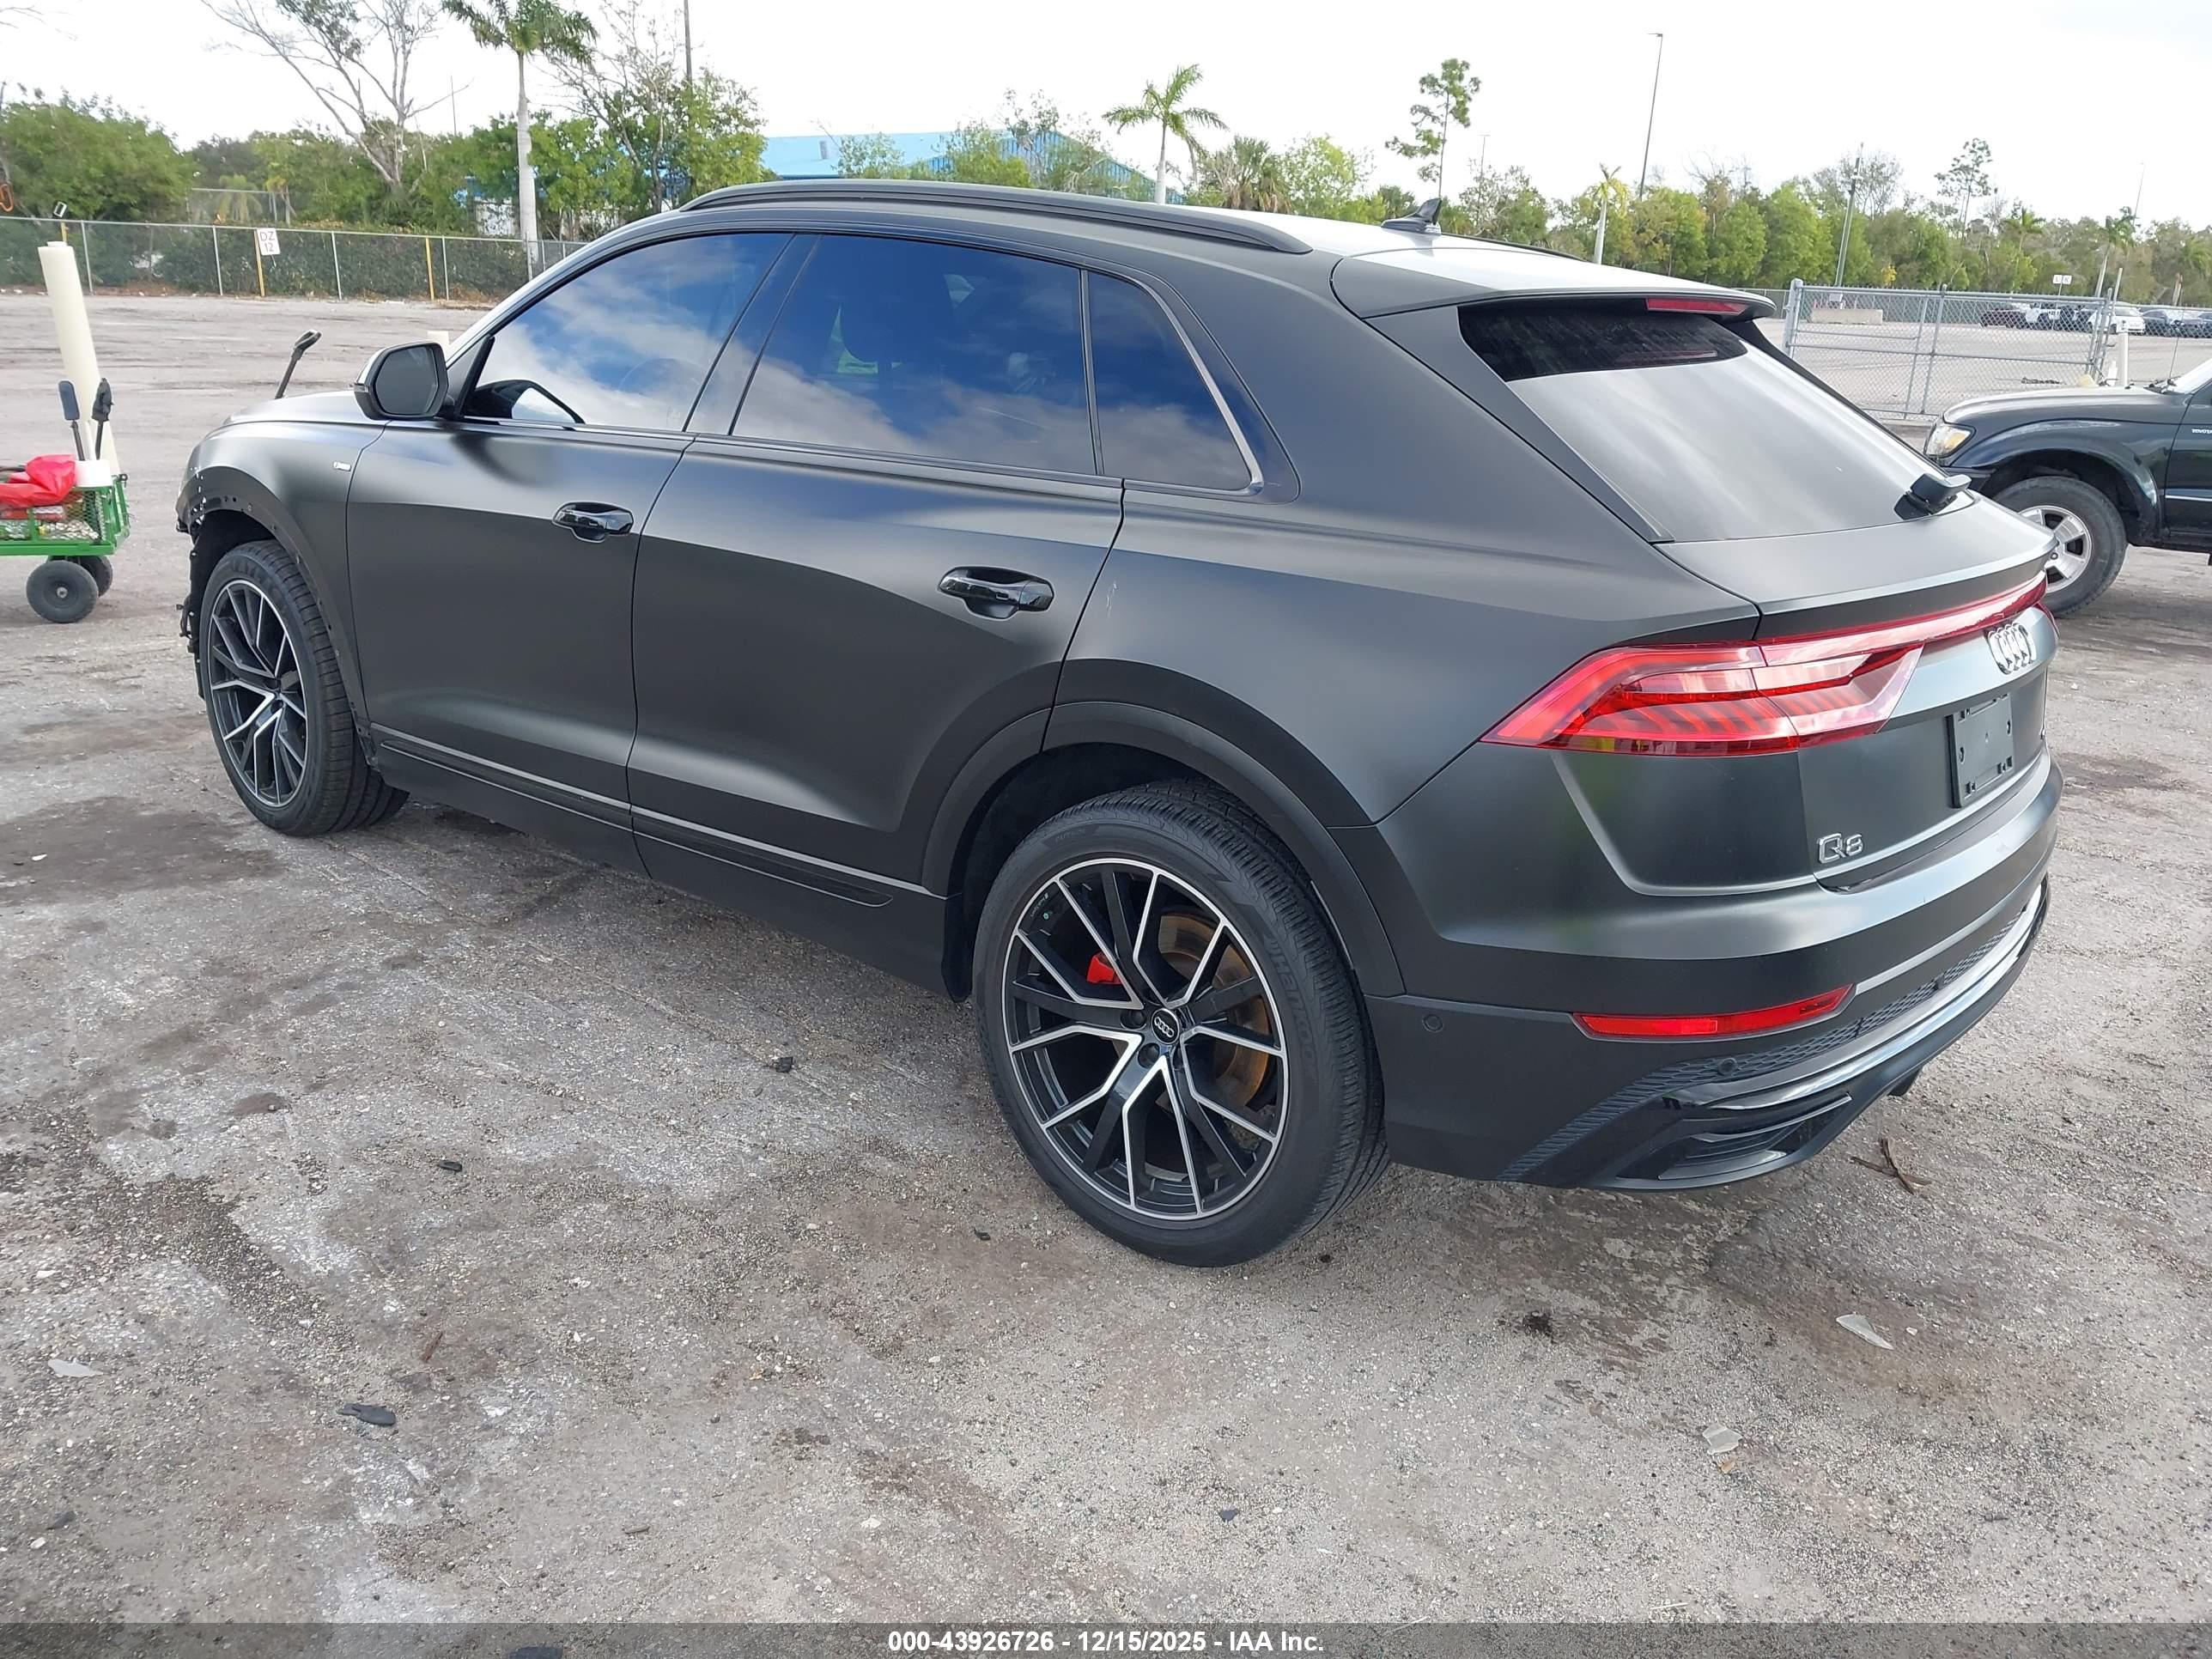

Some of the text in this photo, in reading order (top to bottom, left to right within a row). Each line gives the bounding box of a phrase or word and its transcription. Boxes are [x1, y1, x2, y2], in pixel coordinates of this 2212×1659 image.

[260, 231, 275, 241] DZ
[264, 241, 274, 252] 12
[1819, 833, 1863, 864] Q8
